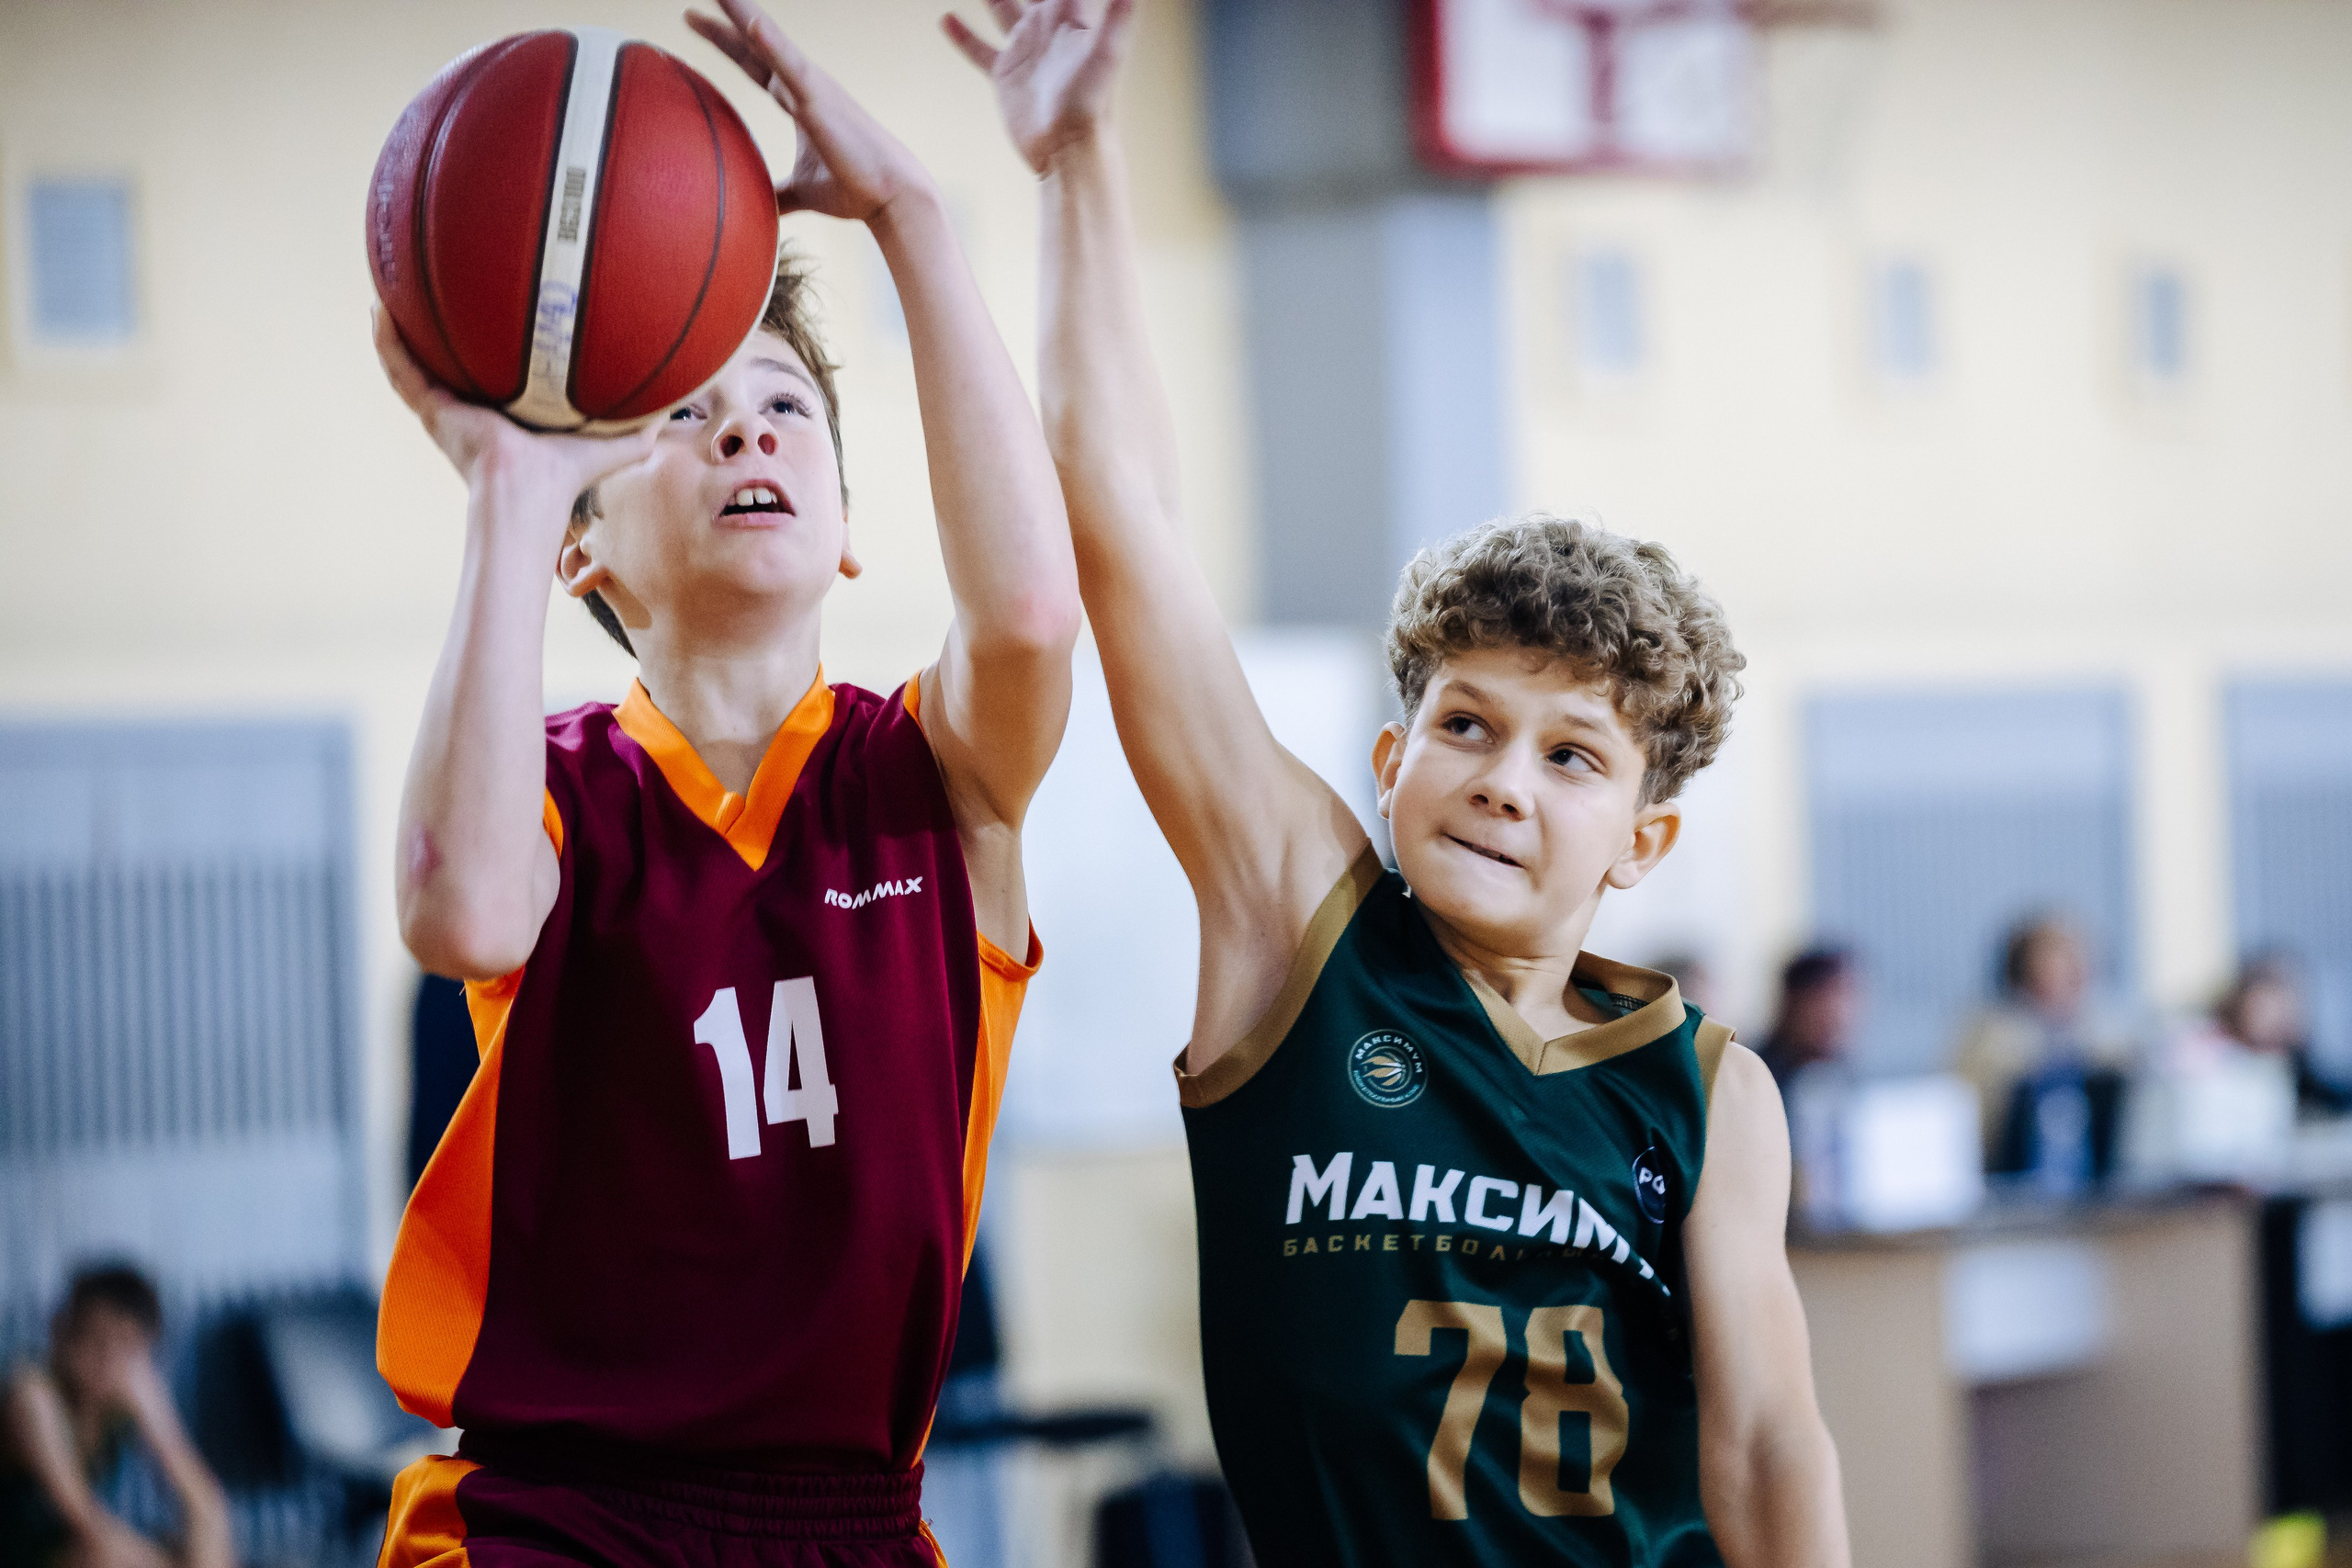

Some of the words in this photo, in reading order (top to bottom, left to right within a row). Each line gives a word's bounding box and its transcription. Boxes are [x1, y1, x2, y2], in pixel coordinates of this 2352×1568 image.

[824, 875, 923, 909] ROMMAX
[694, 976, 839, 1160] 14
[1393, 1298, 1630, 1521] 78
